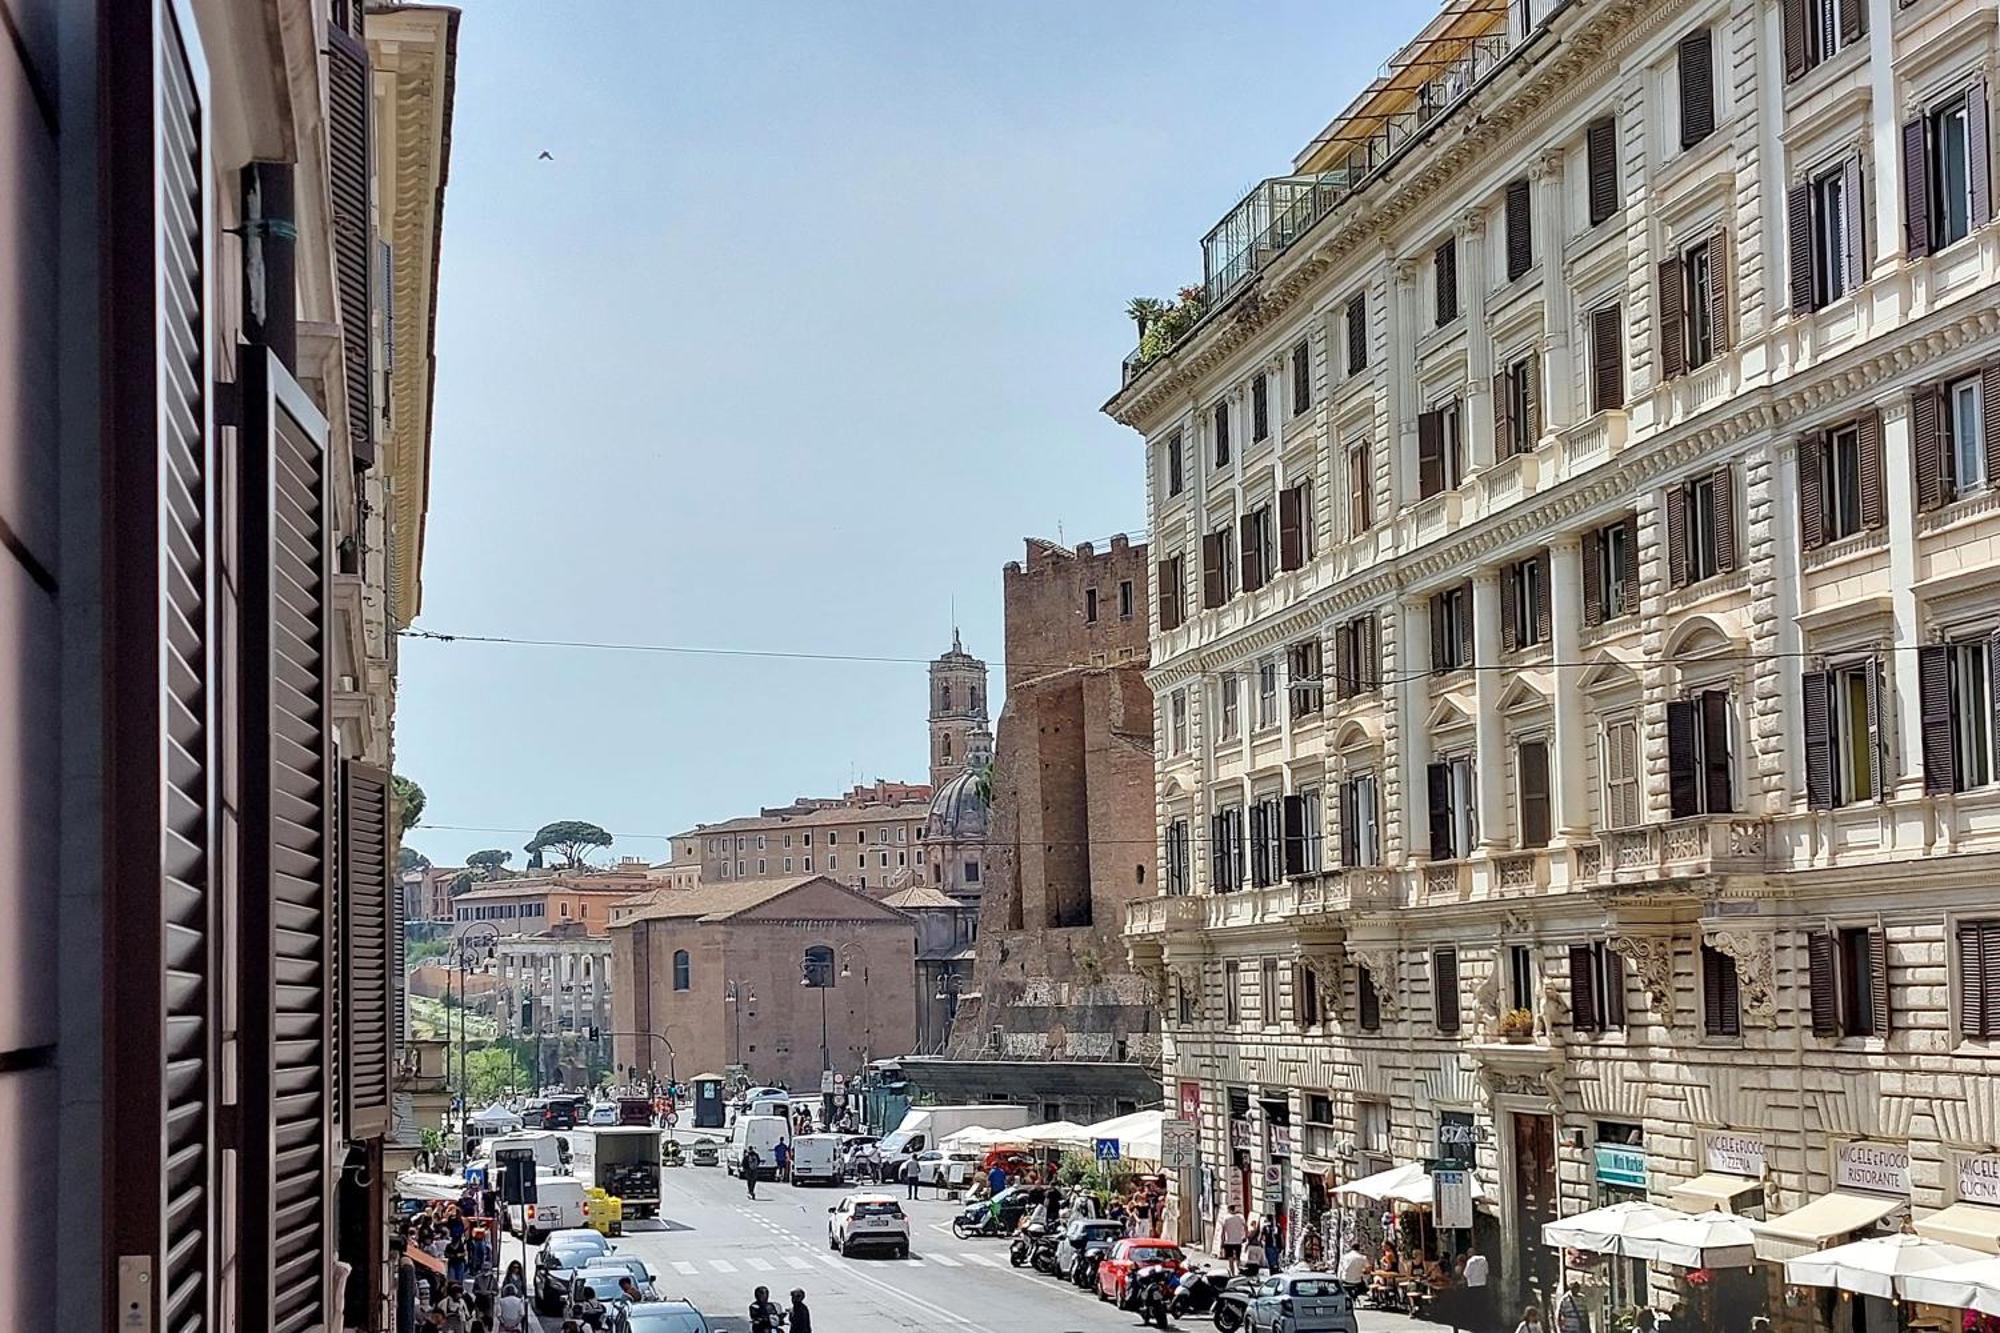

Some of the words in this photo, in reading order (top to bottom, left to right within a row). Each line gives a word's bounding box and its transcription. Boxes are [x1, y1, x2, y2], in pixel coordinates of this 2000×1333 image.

[1721, 1155, 1752, 1171] PIZZERIA
[1879, 1151, 1908, 1169] FUOCO
[1847, 1167, 1900, 1187] RISTORANTE
[1959, 1180, 1998, 1199] CUCINA
